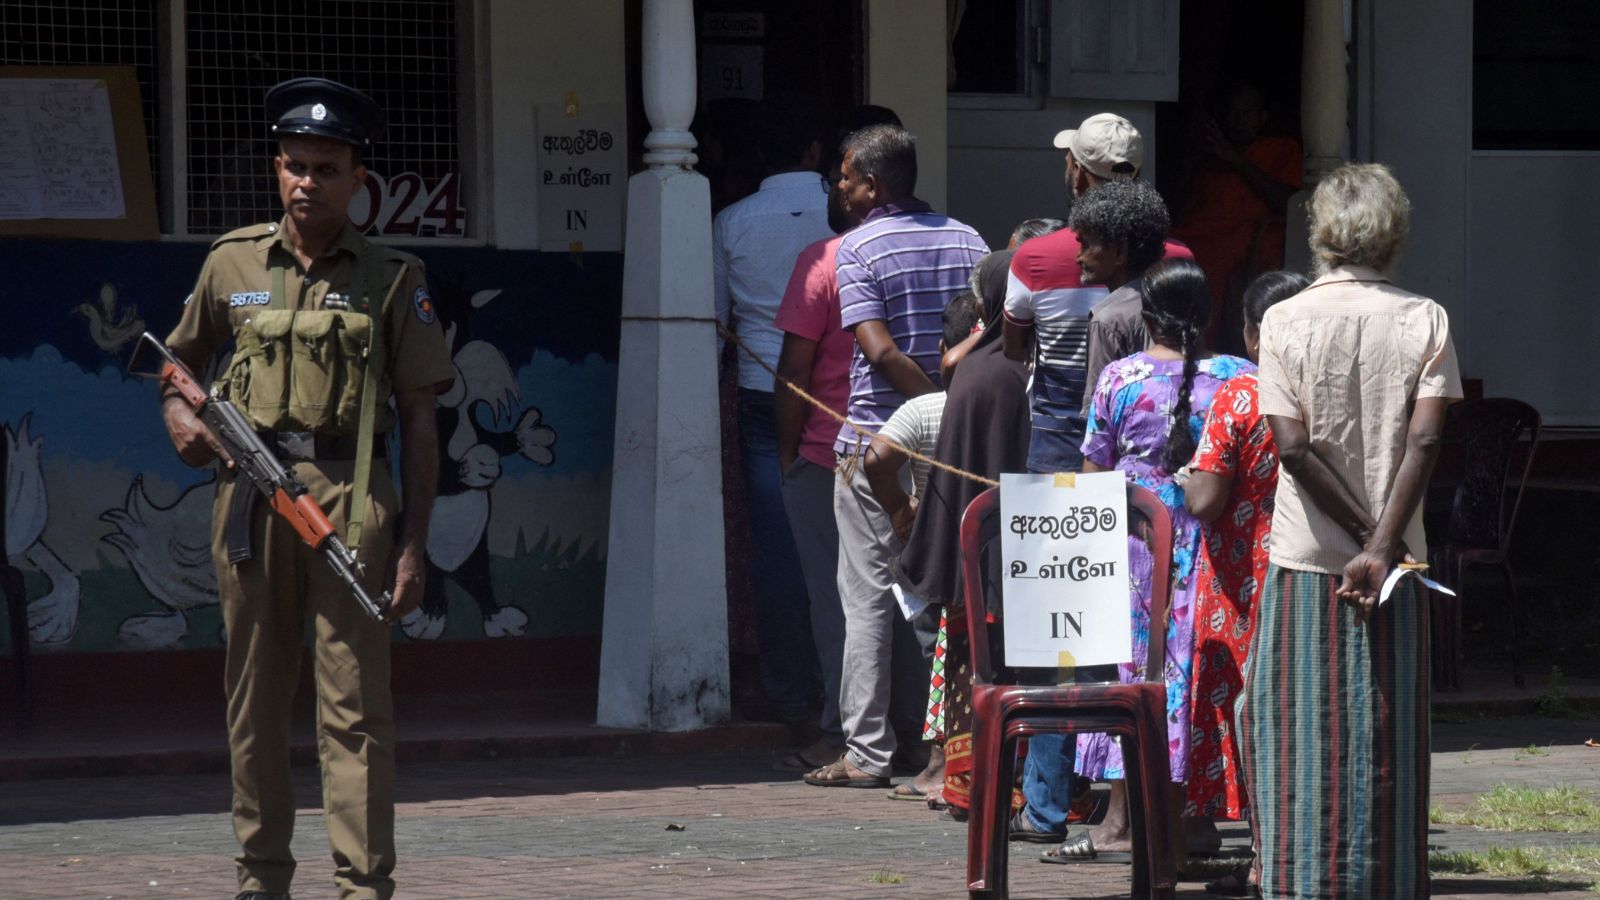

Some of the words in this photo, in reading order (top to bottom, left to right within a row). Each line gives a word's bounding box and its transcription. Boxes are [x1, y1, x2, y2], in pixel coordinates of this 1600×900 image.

[722, 66, 744, 91] 91
[543, 129, 613, 155] ඇතුල්වීම
[543, 167, 612, 188] உள்ளே
[565, 209, 588, 231] IN
[1010, 505, 1118, 540] ඇතුල්වීම
[1010, 555, 1117, 581] உள்ளே
[1049, 611, 1084, 639] IN
